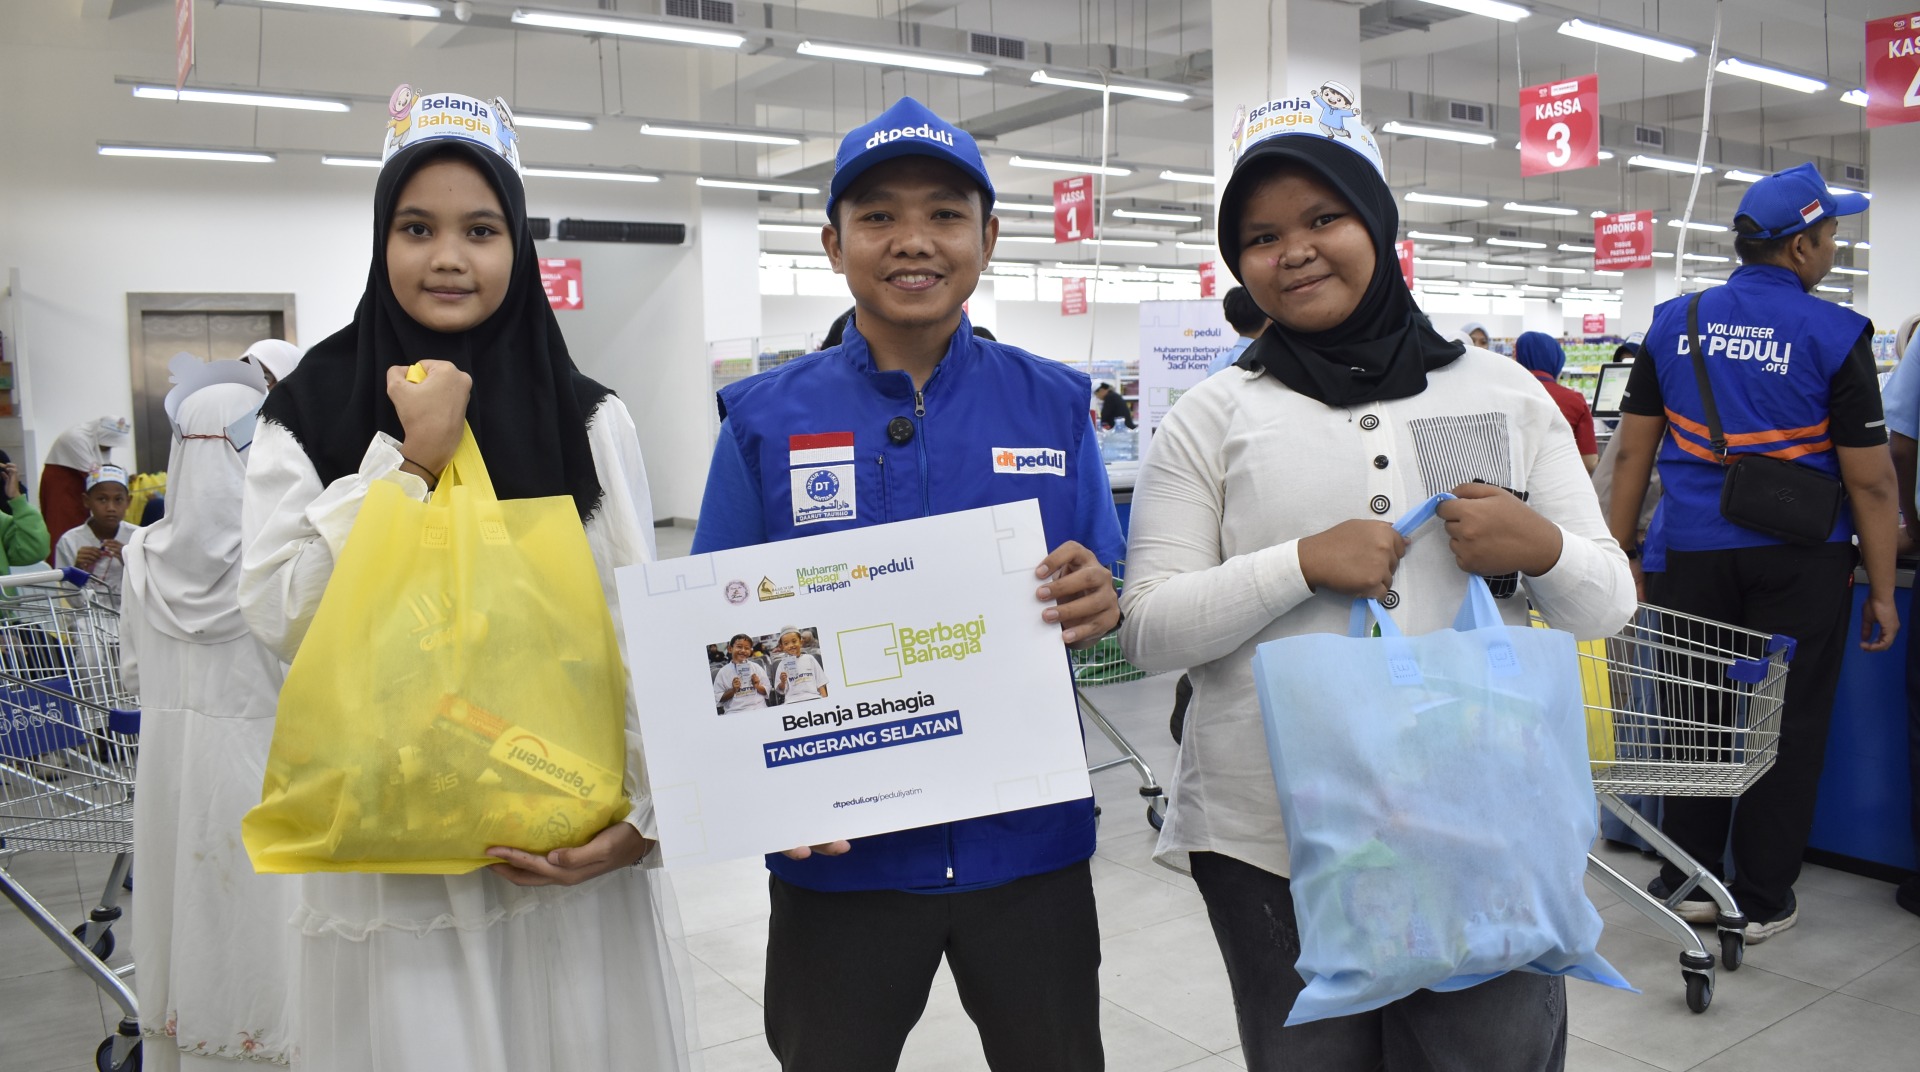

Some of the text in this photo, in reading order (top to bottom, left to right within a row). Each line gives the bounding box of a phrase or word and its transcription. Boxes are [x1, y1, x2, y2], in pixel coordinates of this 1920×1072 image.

[421, 96, 488, 118] Belanja
[1249, 97, 1311, 123] Belanja
[1536, 97, 1582, 120] KASSA
[417, 112, 491, 135] Bahagia
[1246, 112, 1313, 139] Bahagia
[866, 123, 953, 149] dtpeduli
[1547, 122, 1571, 167] 3
[1061, 189, 1085, 204] KASSA
[1067, 206, 1081, 239] 1
[1602, 222, 1636, 235] LORONG
[1184, 328, 1221, 338] dtpeduli
[1707, 322, 1774, 339] VOLUNTEER
[1162, 353, 1212, 361] Mengubah
[1193, 346, 1221, 354] Berbagi
[1708, 336, 1791, 364] PEDULI
[1761, 363, 1788, 375] .org
[996, 450, 1062, 471] dtpeduli
[815, 481, 830, 491] DT
[796, 563, 848, 578] Muharram
[798, 572, 839, 586] Berbagi
[851, 557, 915, 580] dtpeduli
[808, 580, 851, 594] Harapan
[898, 615, 986, 648] Berbagi
[902, 639, 982, 666] Bahagia
[782, 691, 935, 731] Belanja Bahagia
[767, 716, 959, 762] TANGERANG SELATAN
[508, 746, 596, 799] Pepsodent
[832, 787, 923, 808] dtpeduli.org/peduliyatim
